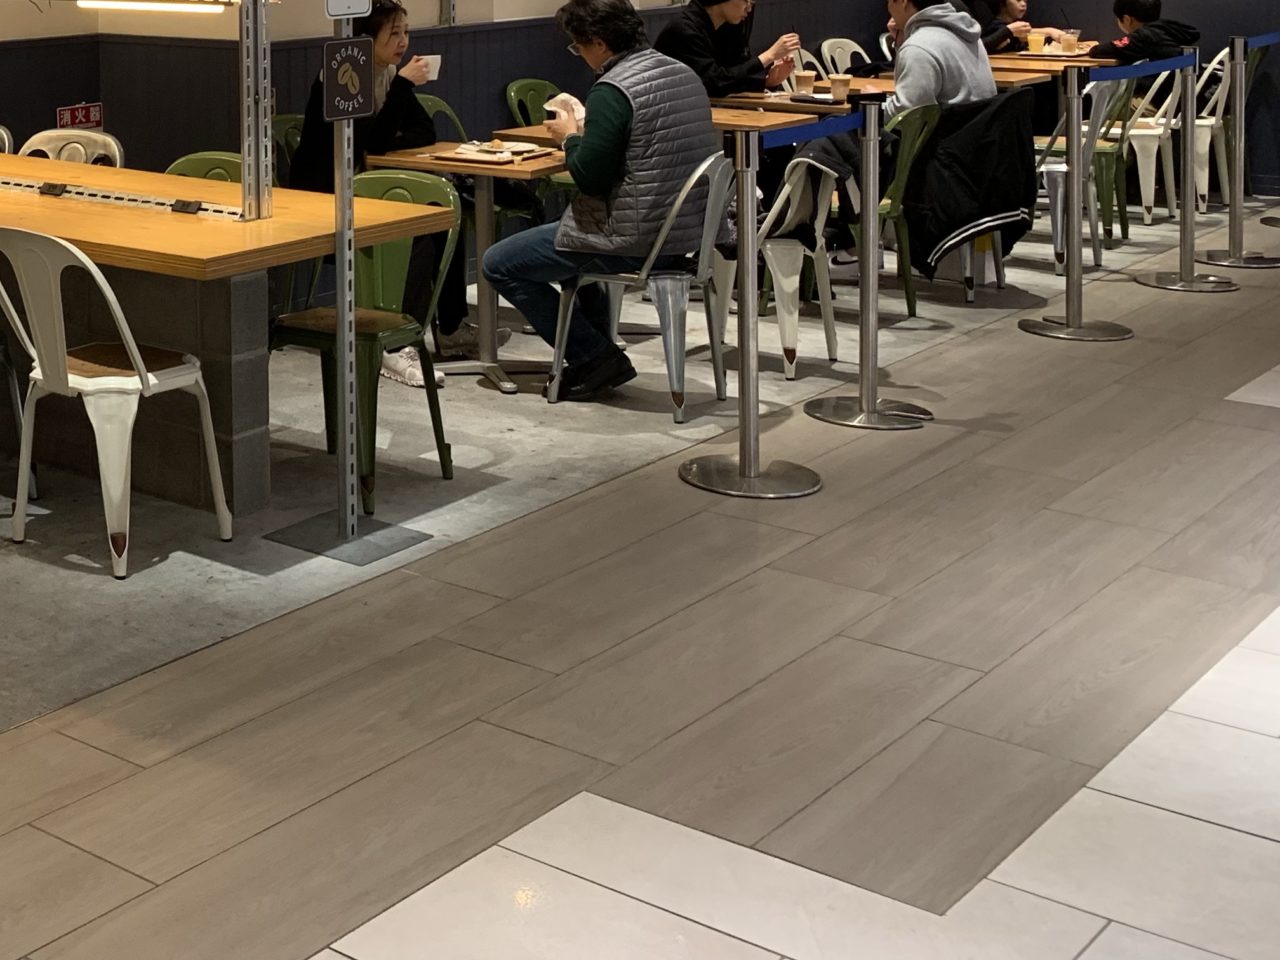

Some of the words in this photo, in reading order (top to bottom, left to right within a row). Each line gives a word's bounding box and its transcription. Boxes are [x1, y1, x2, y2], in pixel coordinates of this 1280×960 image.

[331, 45, 367, 69] ORGANIC
[335, 94, 364, 112] COFFEE
[60, 106, 101, 126] 消火器
